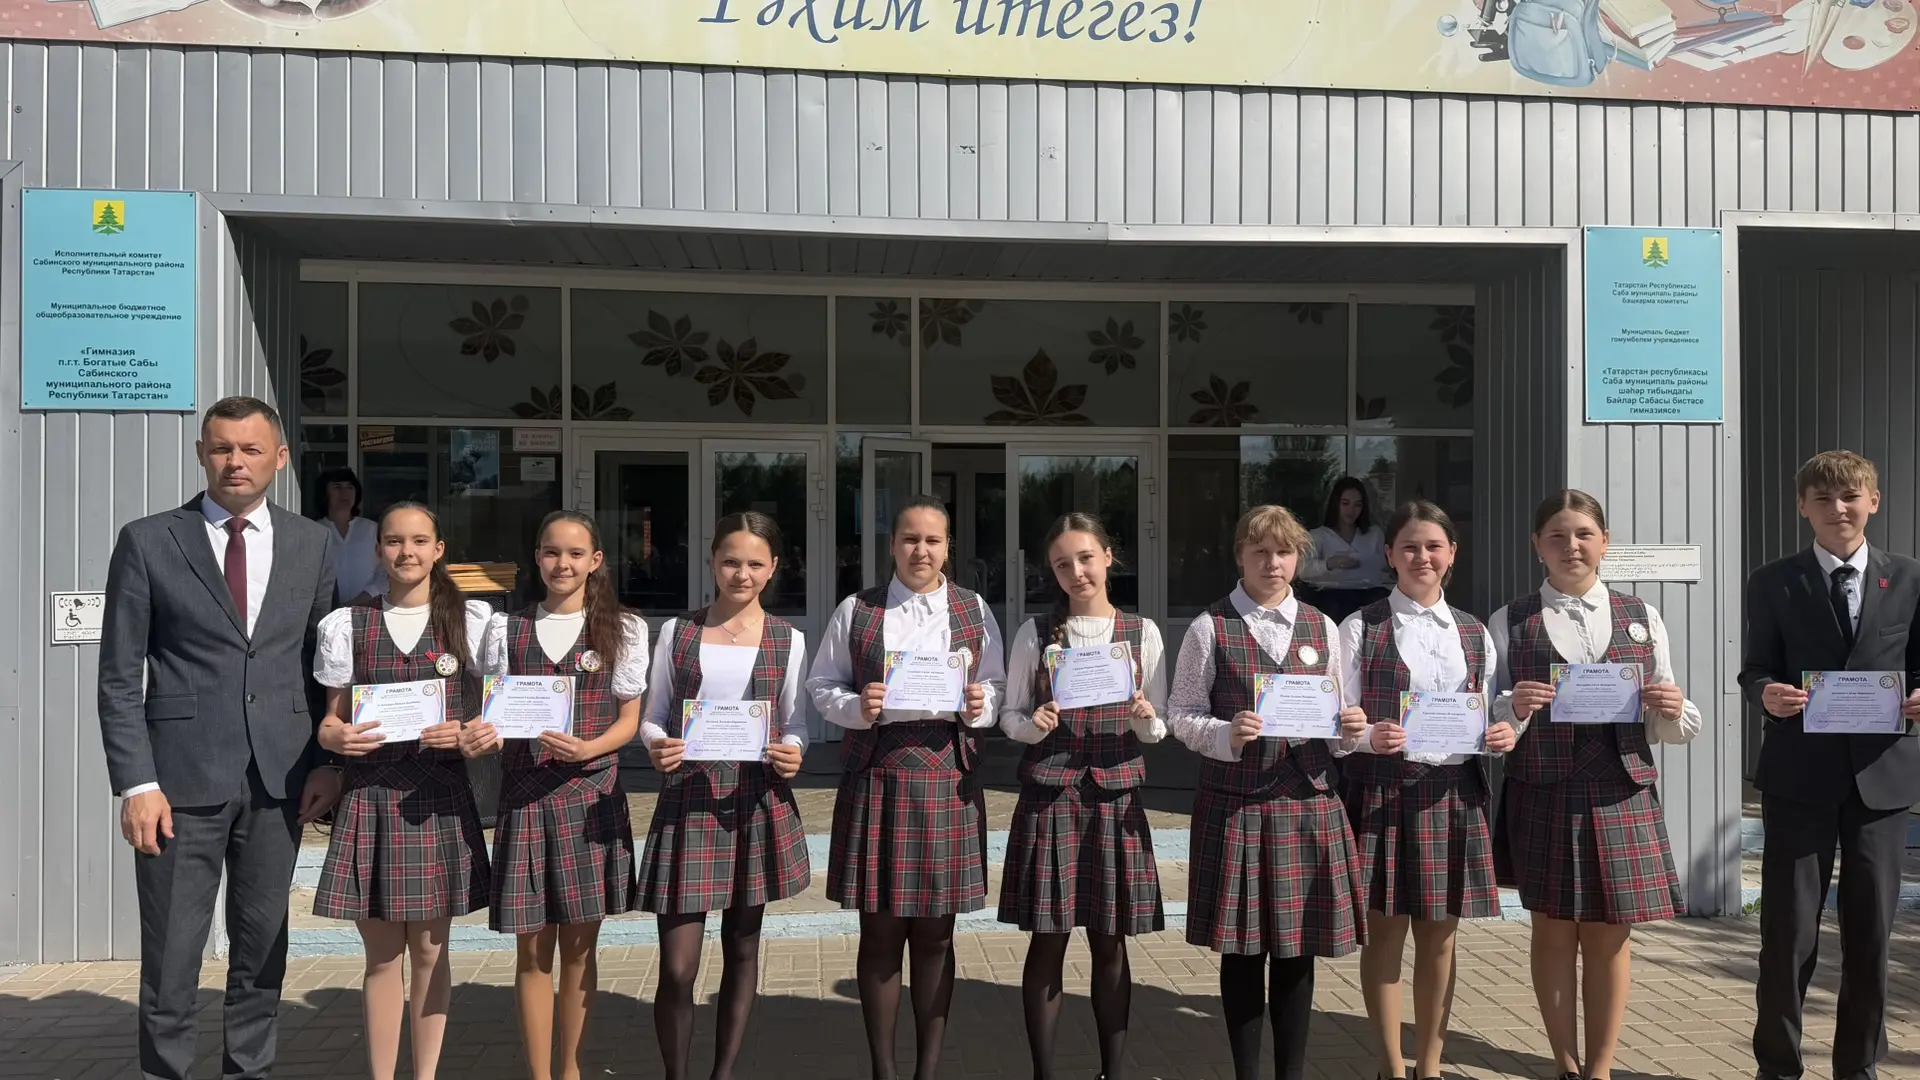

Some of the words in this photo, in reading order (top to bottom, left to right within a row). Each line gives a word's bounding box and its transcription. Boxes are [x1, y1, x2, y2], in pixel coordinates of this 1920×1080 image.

[54, 250, 126, 258] Исполнительный
[33, 258, 81, 267] Сабинского
[82, 260, 152, 269] муниципального
[154, 261, 185, 269] района
[62, 268, 111, 276] Республики
[113, 268, 155, 276] Татарстан
[1649, 282, 1696, 290] Республикасы
[1673, 290, 1698, 298] районы
[51, 302, 117, 311] Муниципальное
[119, 304, 166, 312] бюджетное
[36, 312, 129, 320] общеобразовательное
[131, 313, 182, 321] учреждение
[1621, 328, 1663, 336] Муниципаль
[80, 347, 135, 356] «Гимназия
[83, 358, 127, 367] Богатые
[129, 358, 158, 367] Сабы
[78, 368, 138, 378] Сабинского
[1602, 368, 1648, 376] «Татарстан
[1650, 368, 1708, 377] республикасы
[46, 381, 132, 390] муниципального
[134, 381, 172, 390] района
[1602, 377, 1623, 385] Саба
[1625, 378, 1675, 387] муниципаль
[1677, 377, 1708, 387] районы
[48, 391, 109, 401] Республики
[111, 391, 168, 400] Татарстан»
[1606, 397, 1636, 406] Байлар
[1638, 397, 1670, 405] Сабасы
